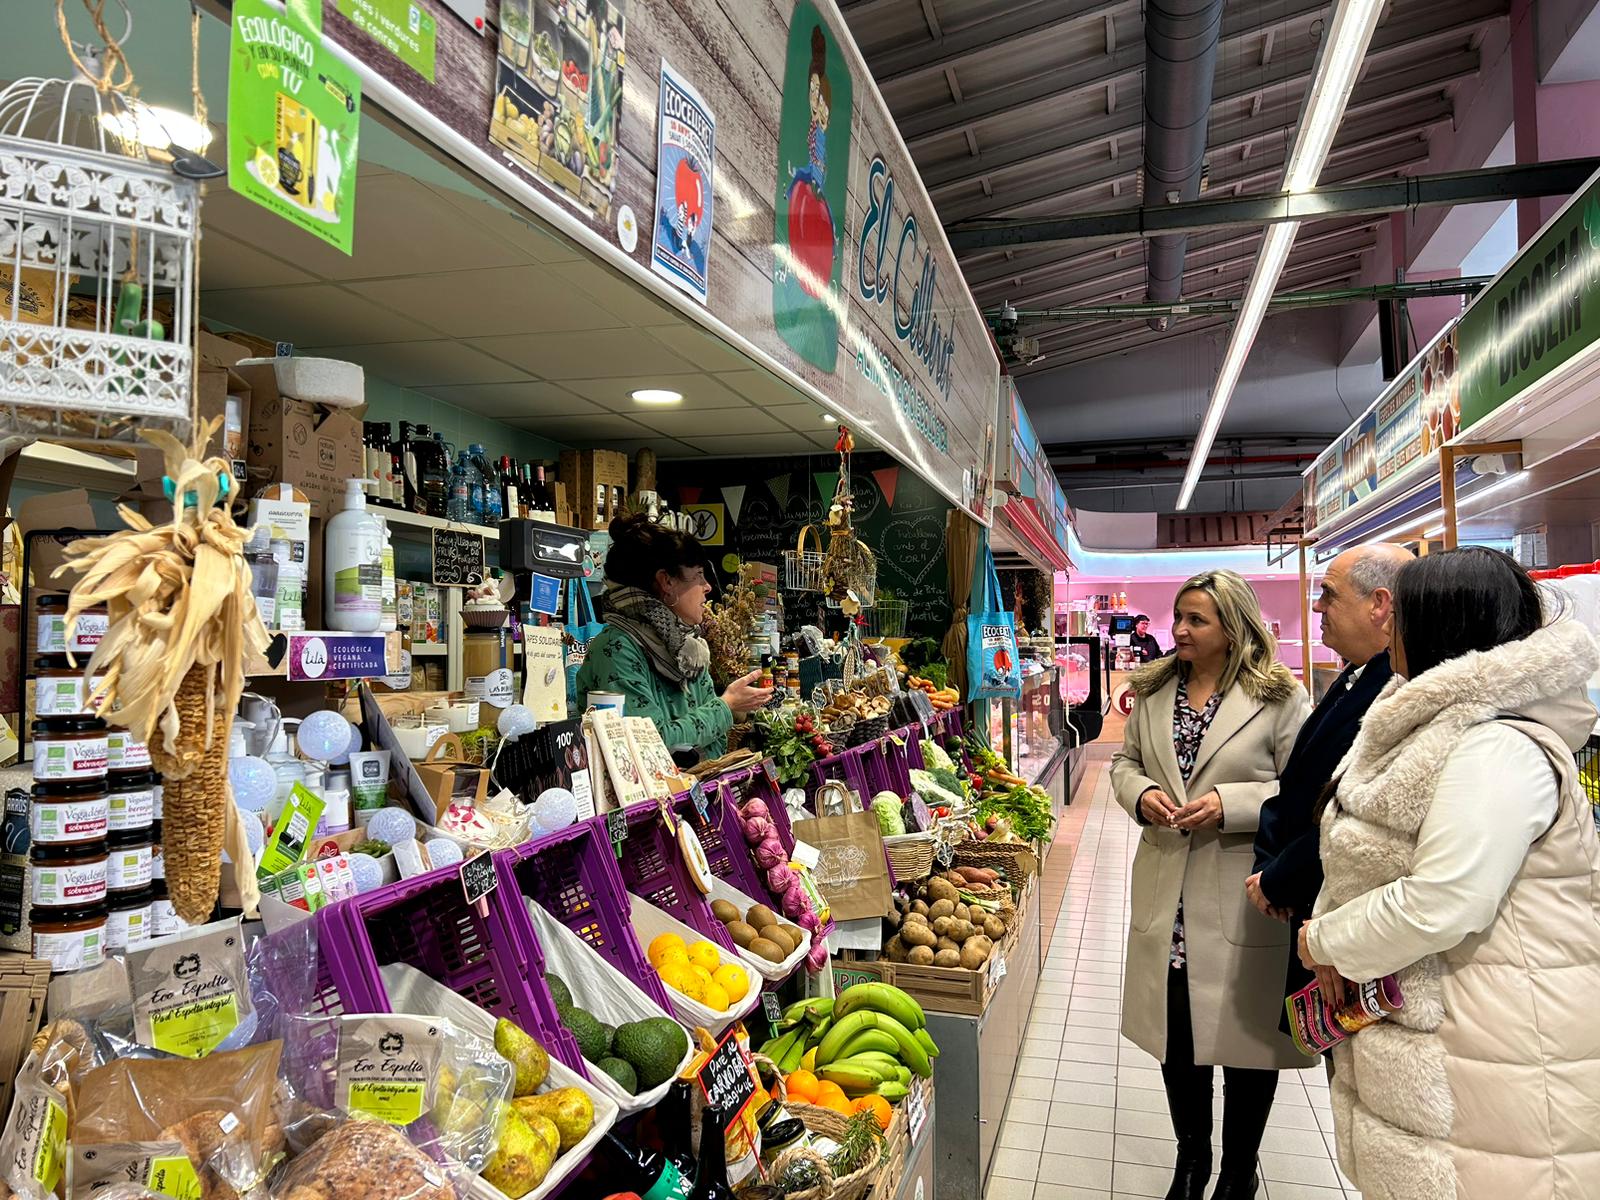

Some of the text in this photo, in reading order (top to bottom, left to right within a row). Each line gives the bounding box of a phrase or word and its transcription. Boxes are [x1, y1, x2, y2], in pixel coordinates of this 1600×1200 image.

[237, 15, 314, 67] ECOLÓGICO
[353, 10, 400, 53] de conreu
[381, 15, 420, 53] verdures
[858, 156, 895, 305] El
[333, 645, 372, 653] ECOLÓGICA
[150, 974, 228, 1004] Eco Espelta
[353, 1058, 424, 1077] Eco Espelta
